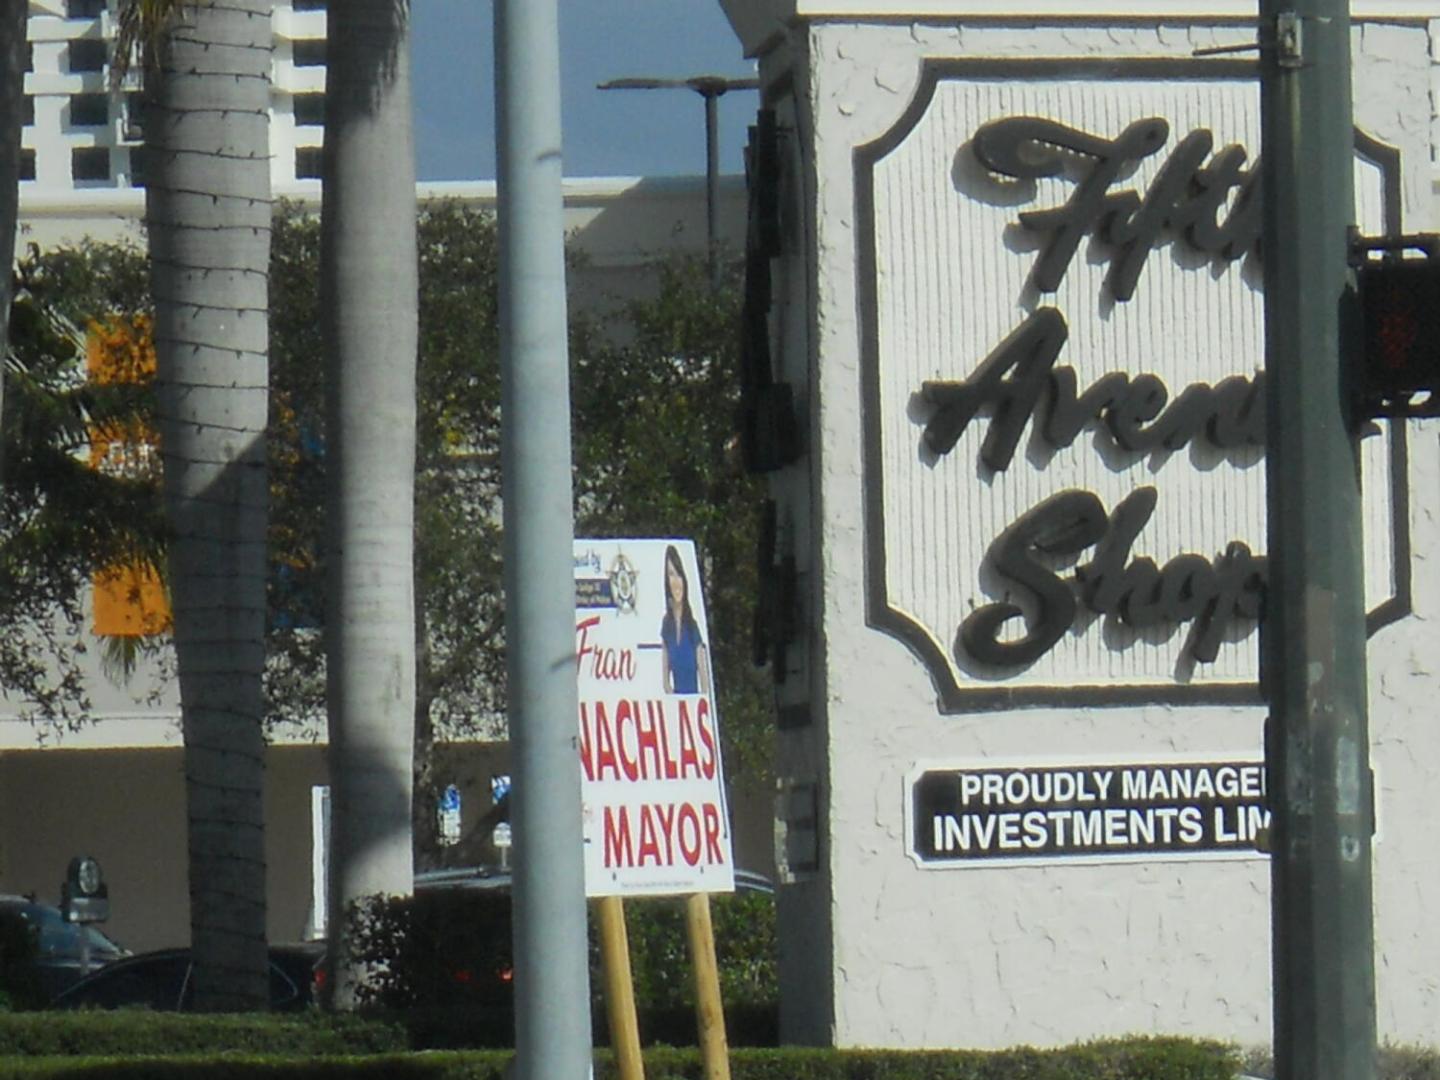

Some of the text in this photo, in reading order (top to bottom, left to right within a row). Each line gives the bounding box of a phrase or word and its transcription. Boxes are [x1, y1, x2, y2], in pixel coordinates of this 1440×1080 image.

[576, 615, 637, 682] Fran
[962, 766, 1266, 805] PROUDLY MANAGE
[604, 802, 723, 868] MAYOR
[933, 808, 1203, 852] INVESTMENTS
